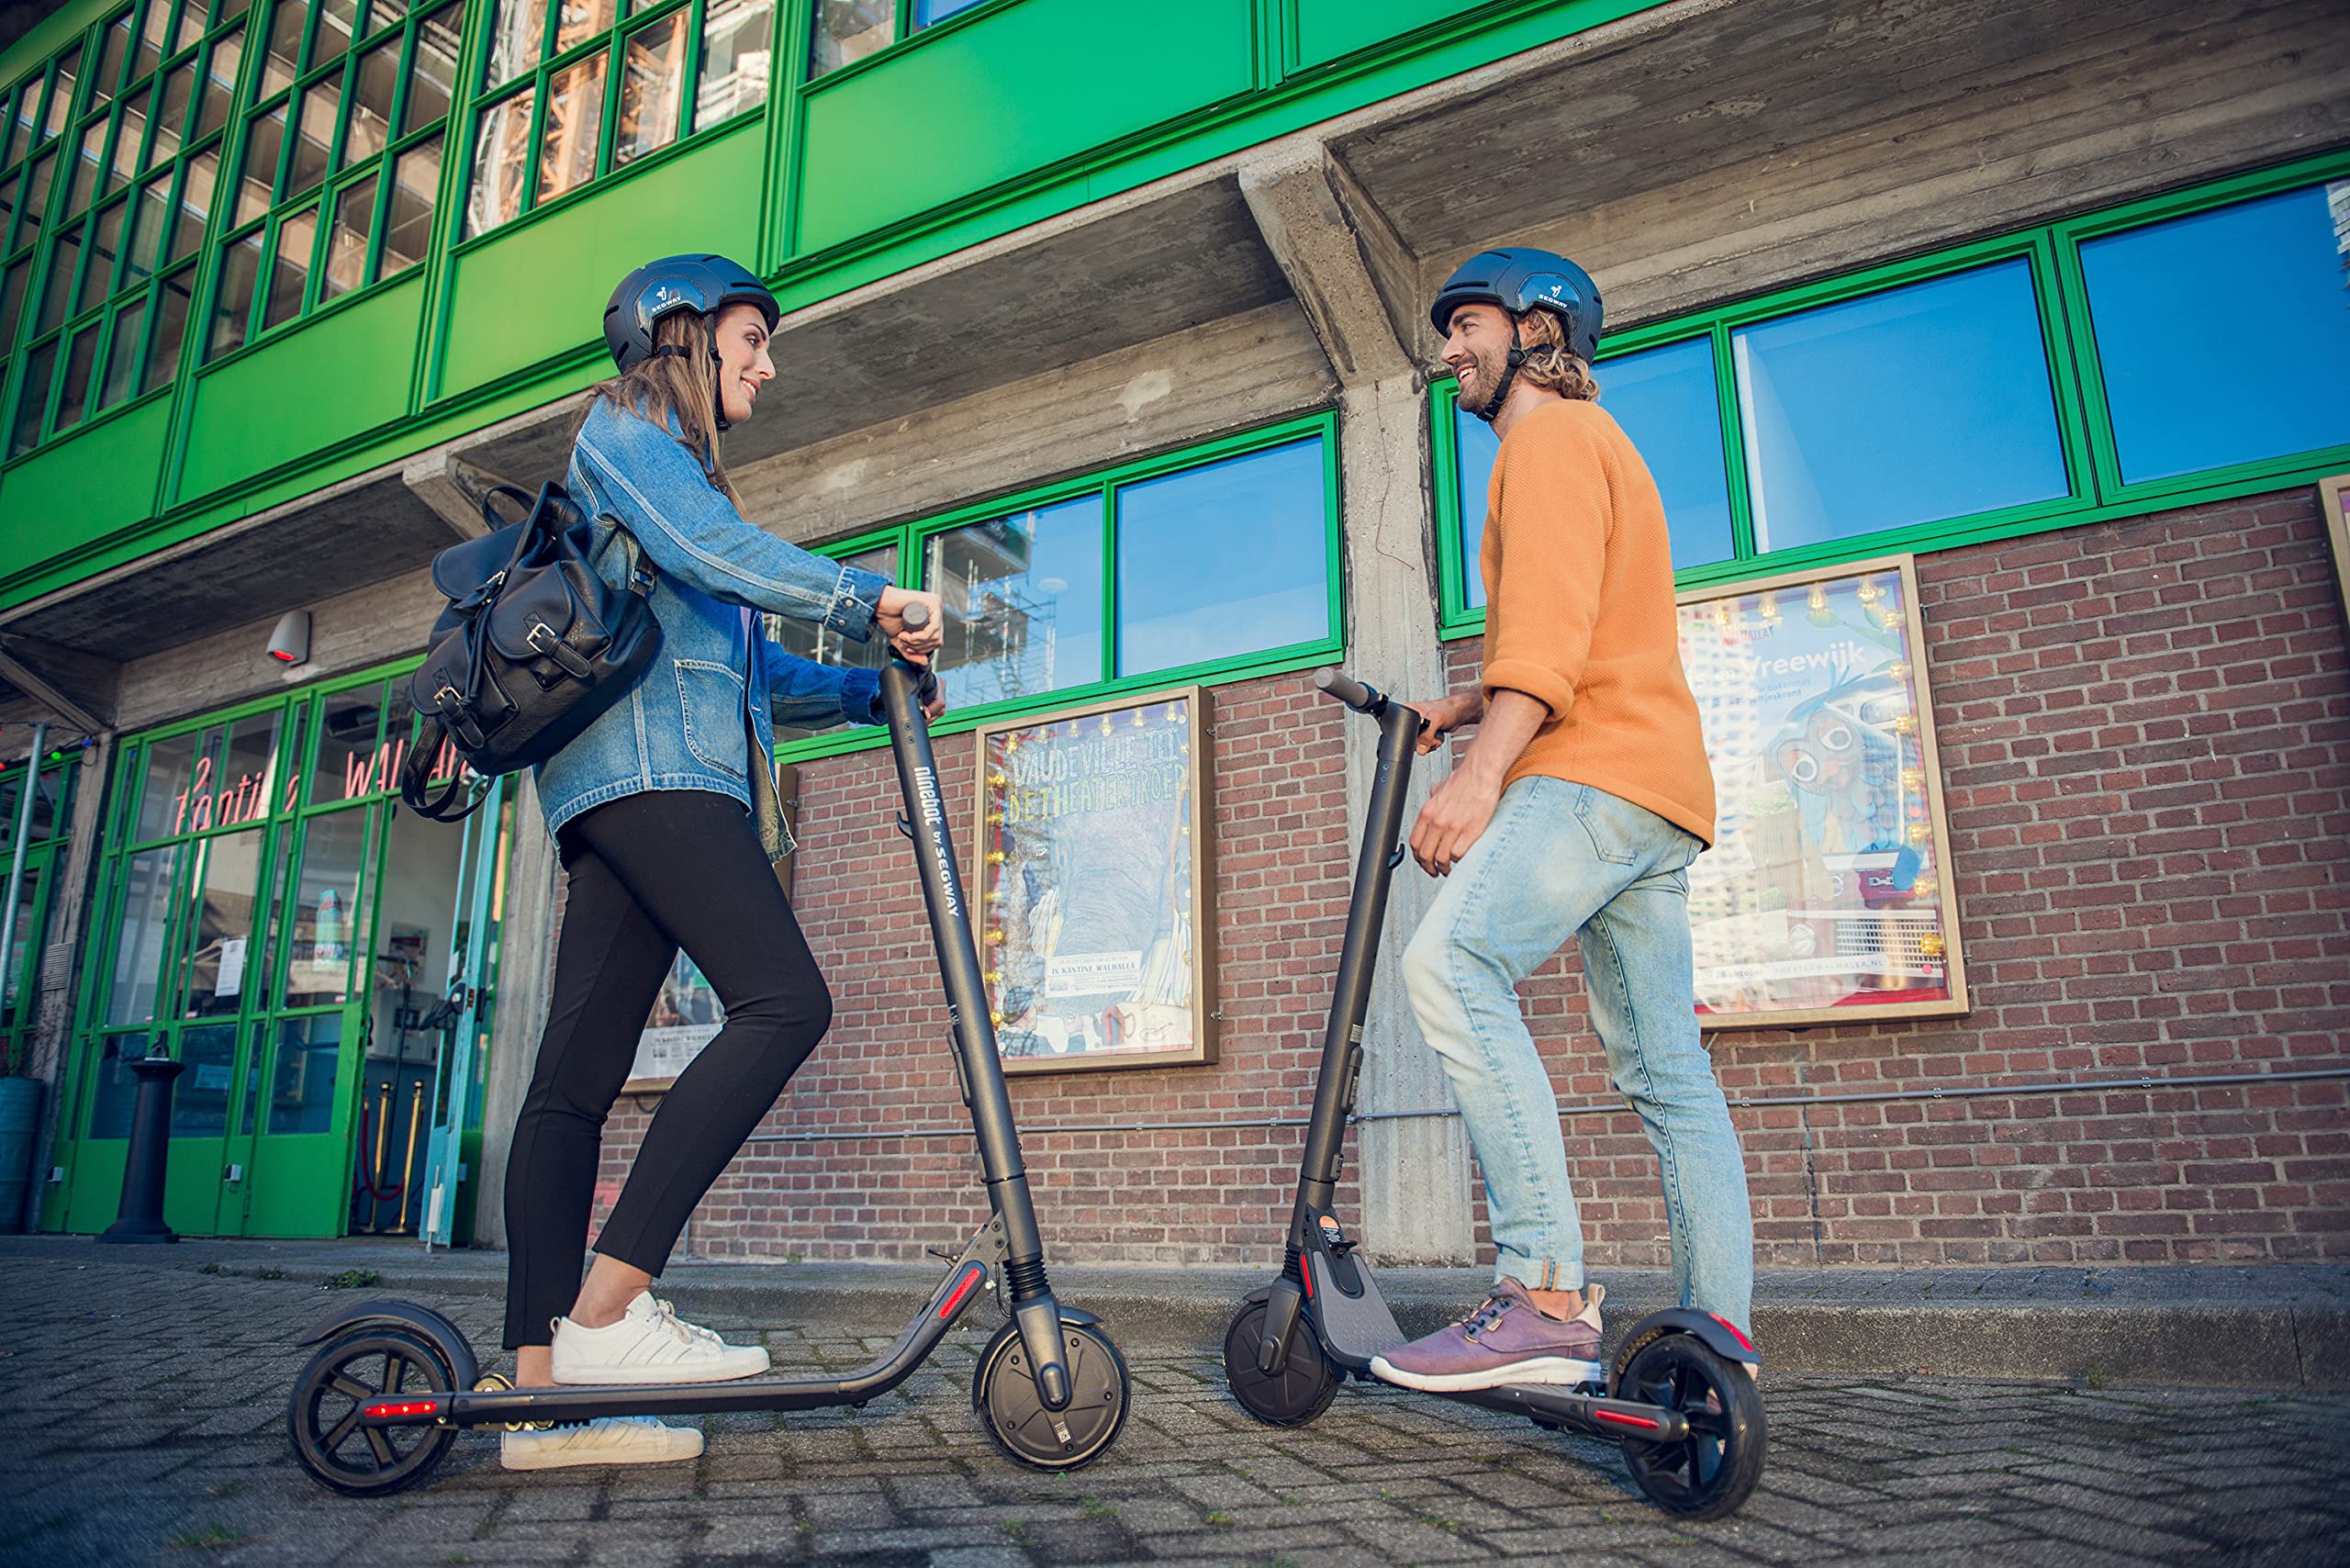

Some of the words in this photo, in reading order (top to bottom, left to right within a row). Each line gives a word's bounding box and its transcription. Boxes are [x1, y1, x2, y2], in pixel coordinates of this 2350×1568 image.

[652, 296, 681, 313] SEGWAY
[1539, 294, 1568, 308] SEGWAY
[1011, 734, 1136, 788] VAUDEVILLE
[914, 767, 942, 826] ninebot
[933, 831, 942, 845] by
[935, 846, 959, 917] SEGWAY
[1061, 964, 1093, 975] KANTINE
[1096, 962, 1136, 971] WALHALLA
